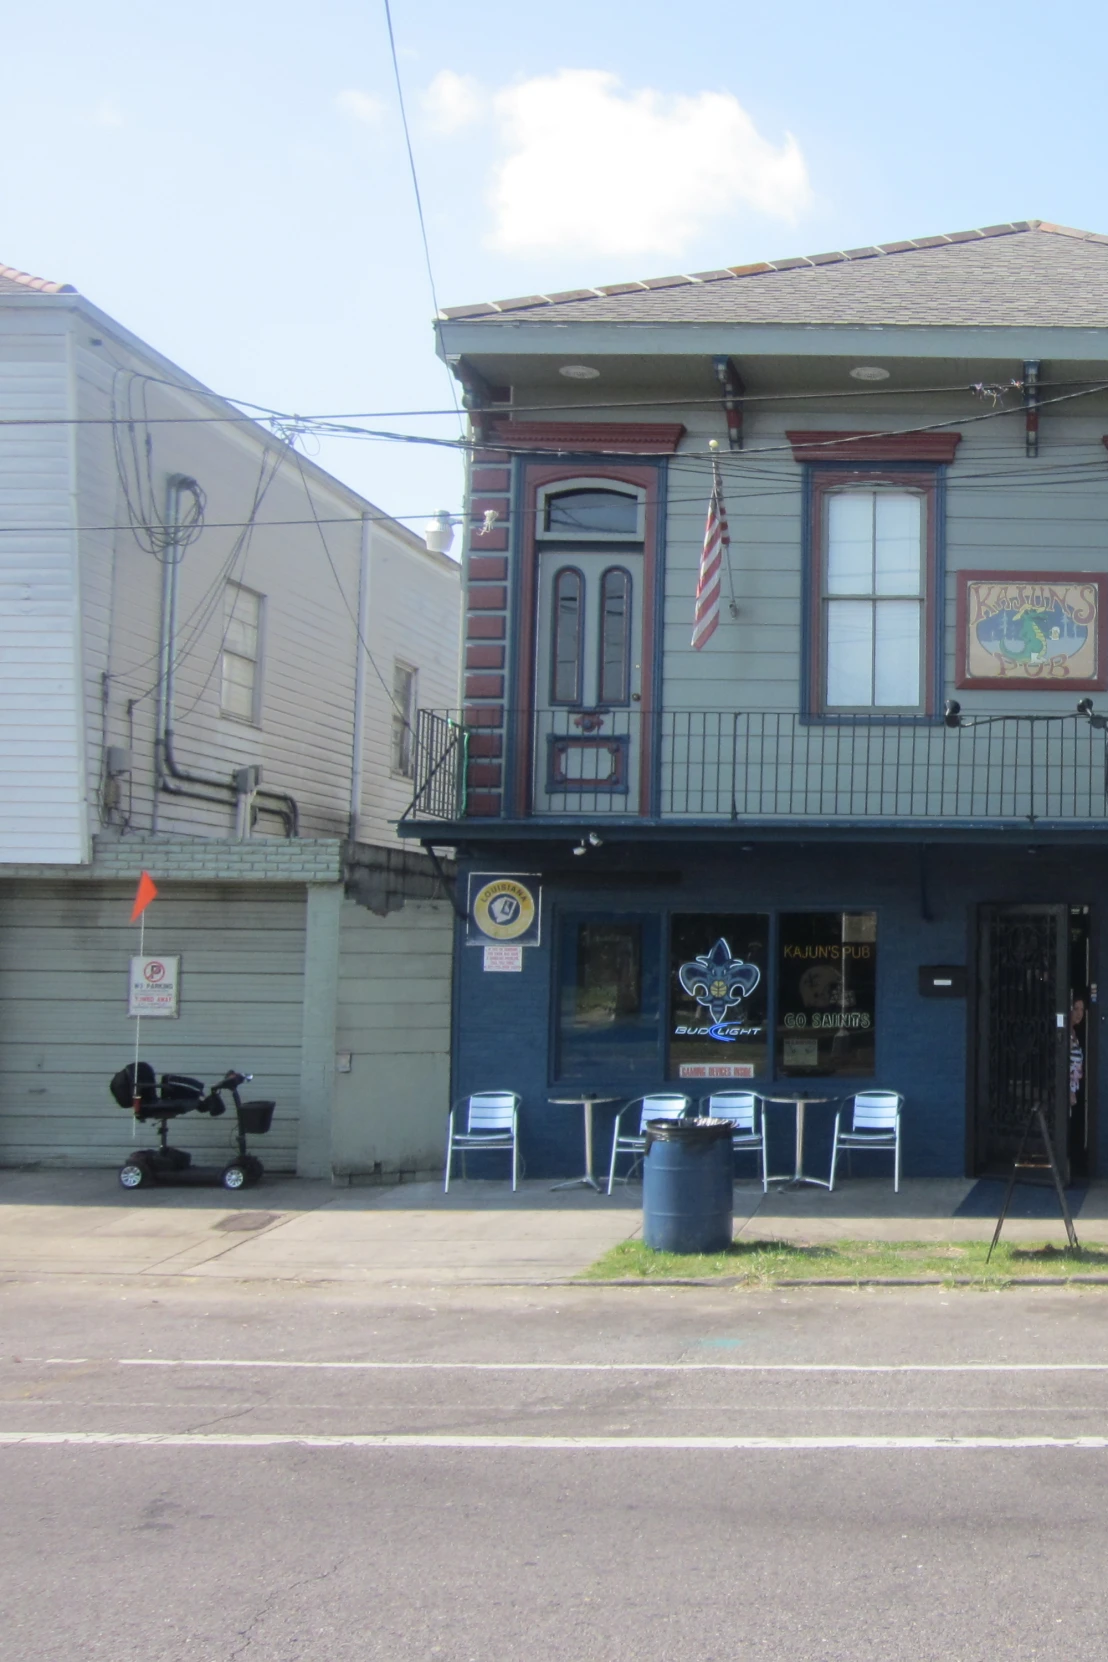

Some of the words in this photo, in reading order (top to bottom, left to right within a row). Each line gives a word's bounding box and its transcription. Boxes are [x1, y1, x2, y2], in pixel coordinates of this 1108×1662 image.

[970, 584, 1097, 626] KAJUN'S
[993, 653, 1070, 678] PUB
[480, 883, 528, 903] LOUISIANA
[783, 945, 840, 959] KAJUN'S
[842, 945, 871, 959] PUB
[783, 1012, 807, 1029] GO
[811, 1012, 871, 1029] SAINTS
[674, 1026, 709, 1035] BUD
[717, 1027, 762, 1036] LIGHT
